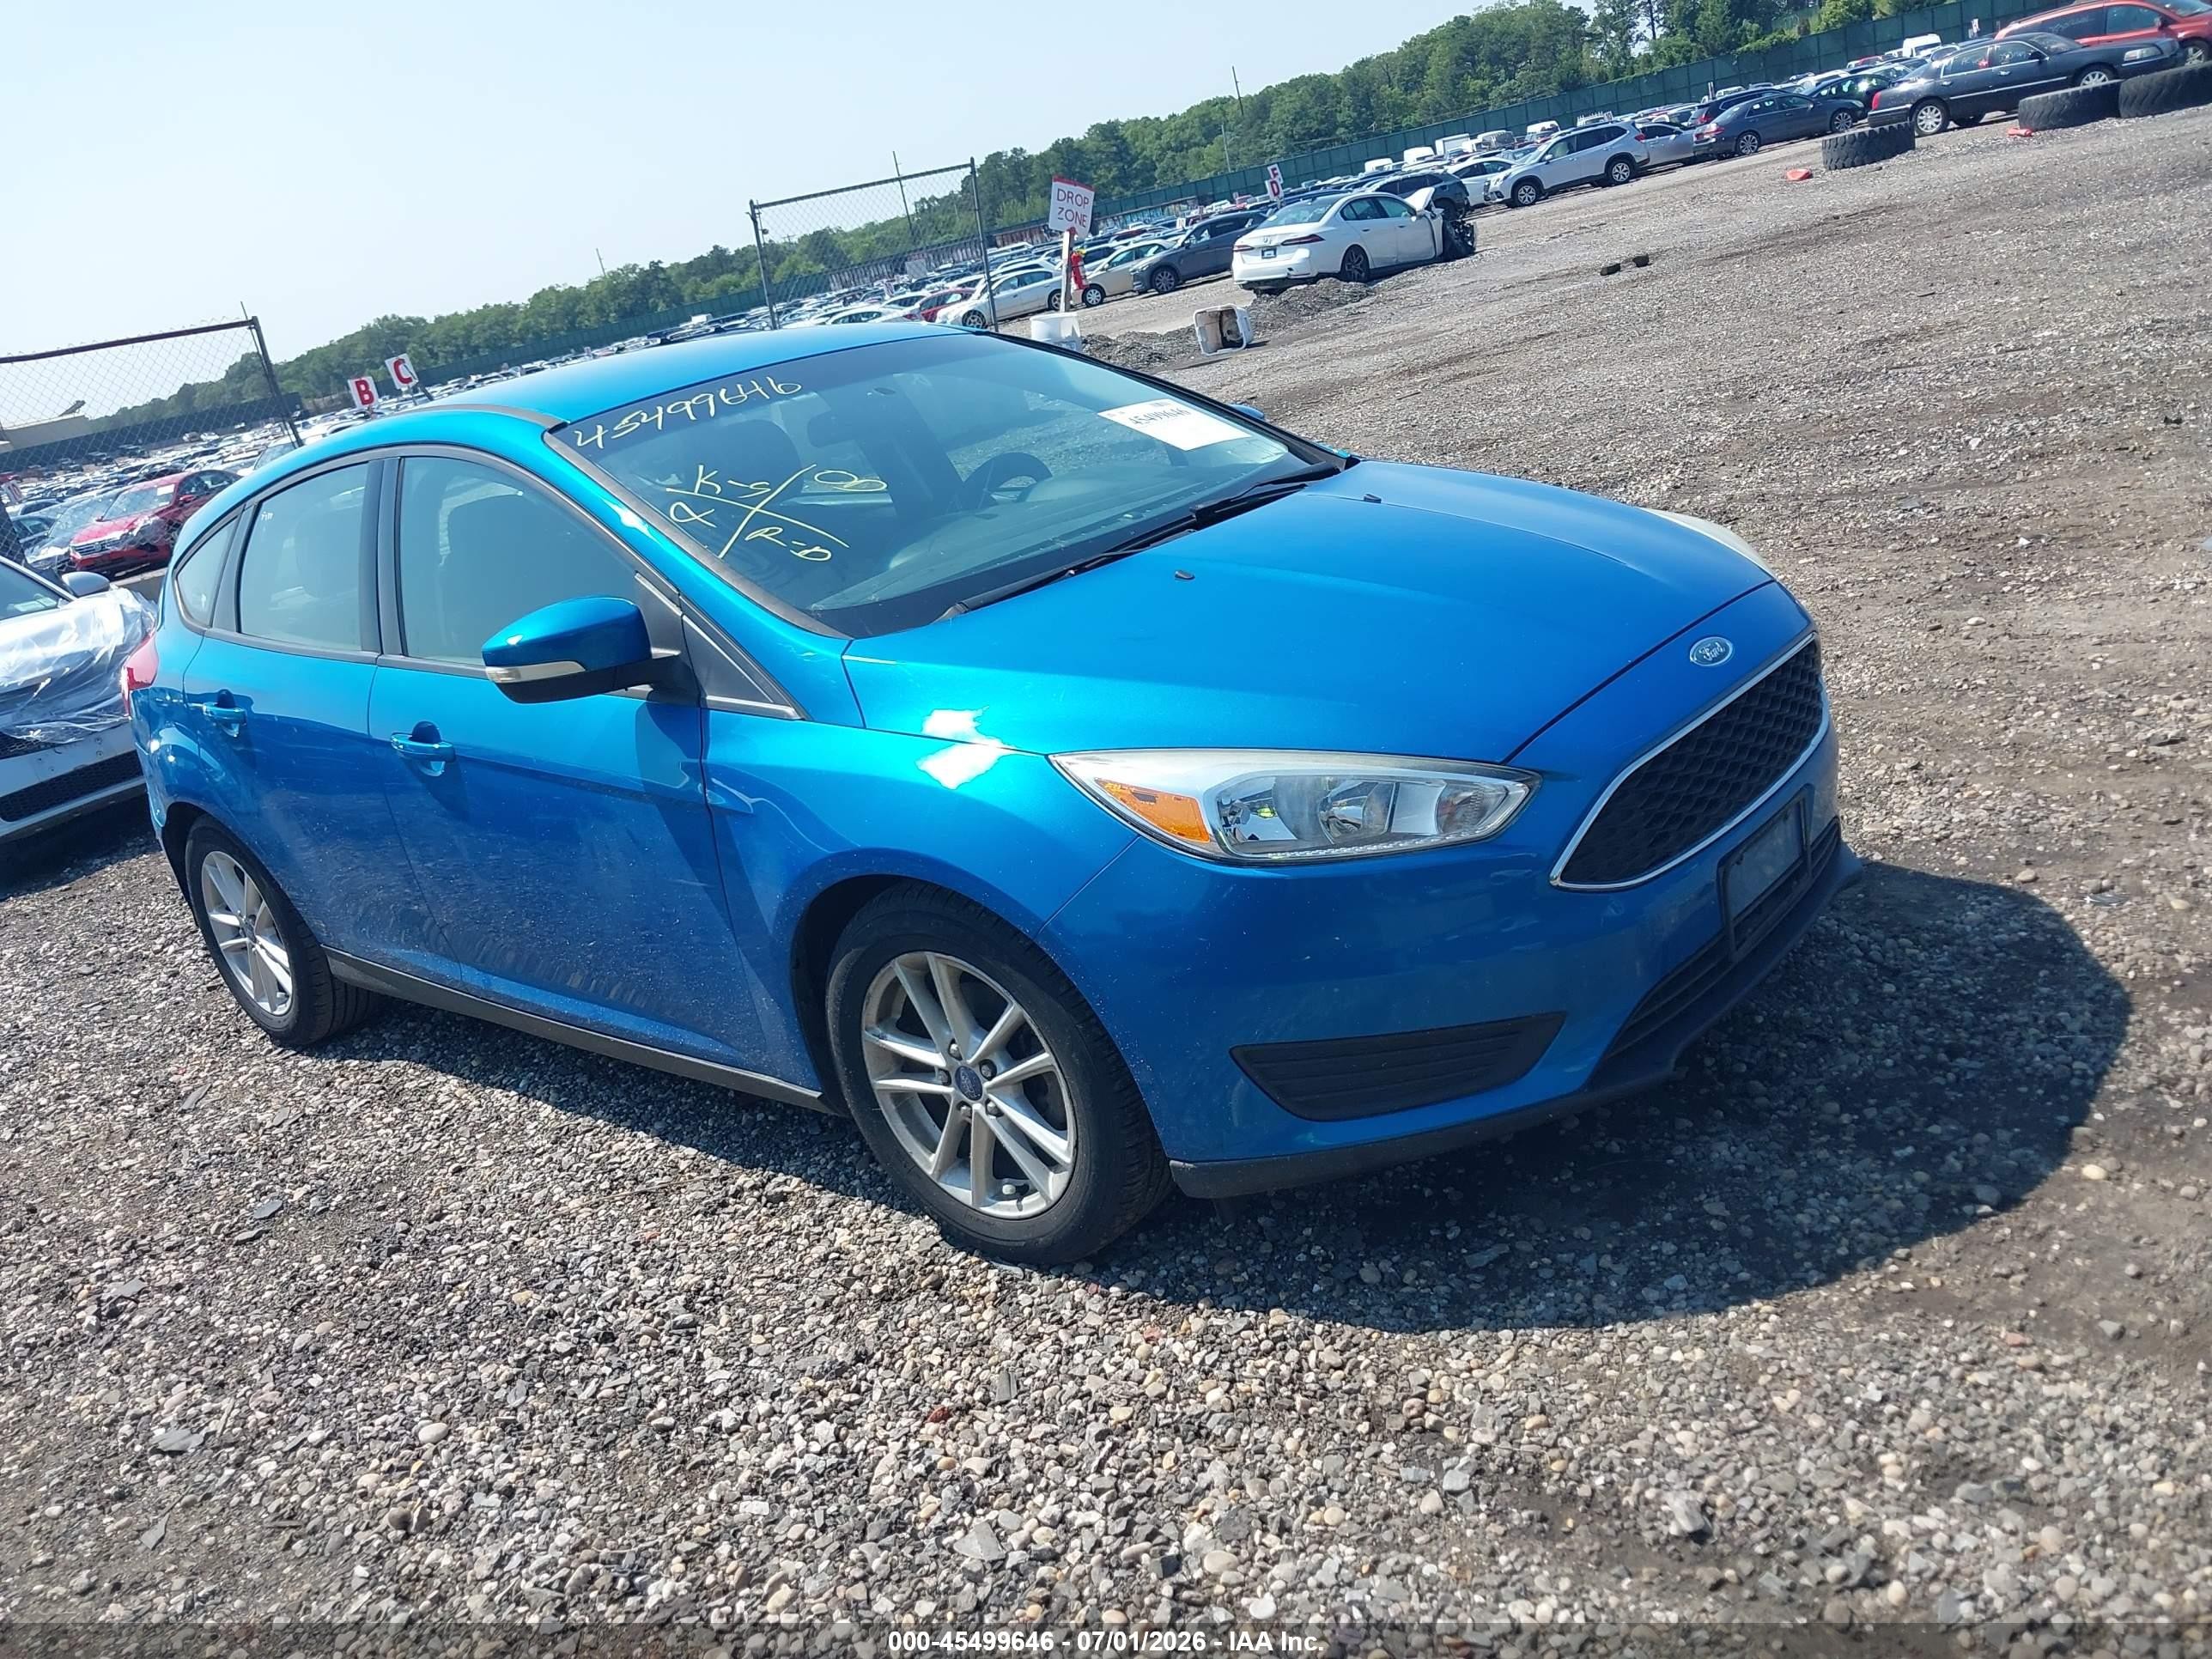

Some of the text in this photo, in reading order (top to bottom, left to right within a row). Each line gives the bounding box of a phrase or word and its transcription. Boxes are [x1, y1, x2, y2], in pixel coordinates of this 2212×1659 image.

[1057, 188, 1089, 208] DROP
[1270, 180, 1280, 197] D
[1058, 207, 1087, 228] ZONE
[393, 358, 413, 384] C
[355, 380, 374, 405] B
